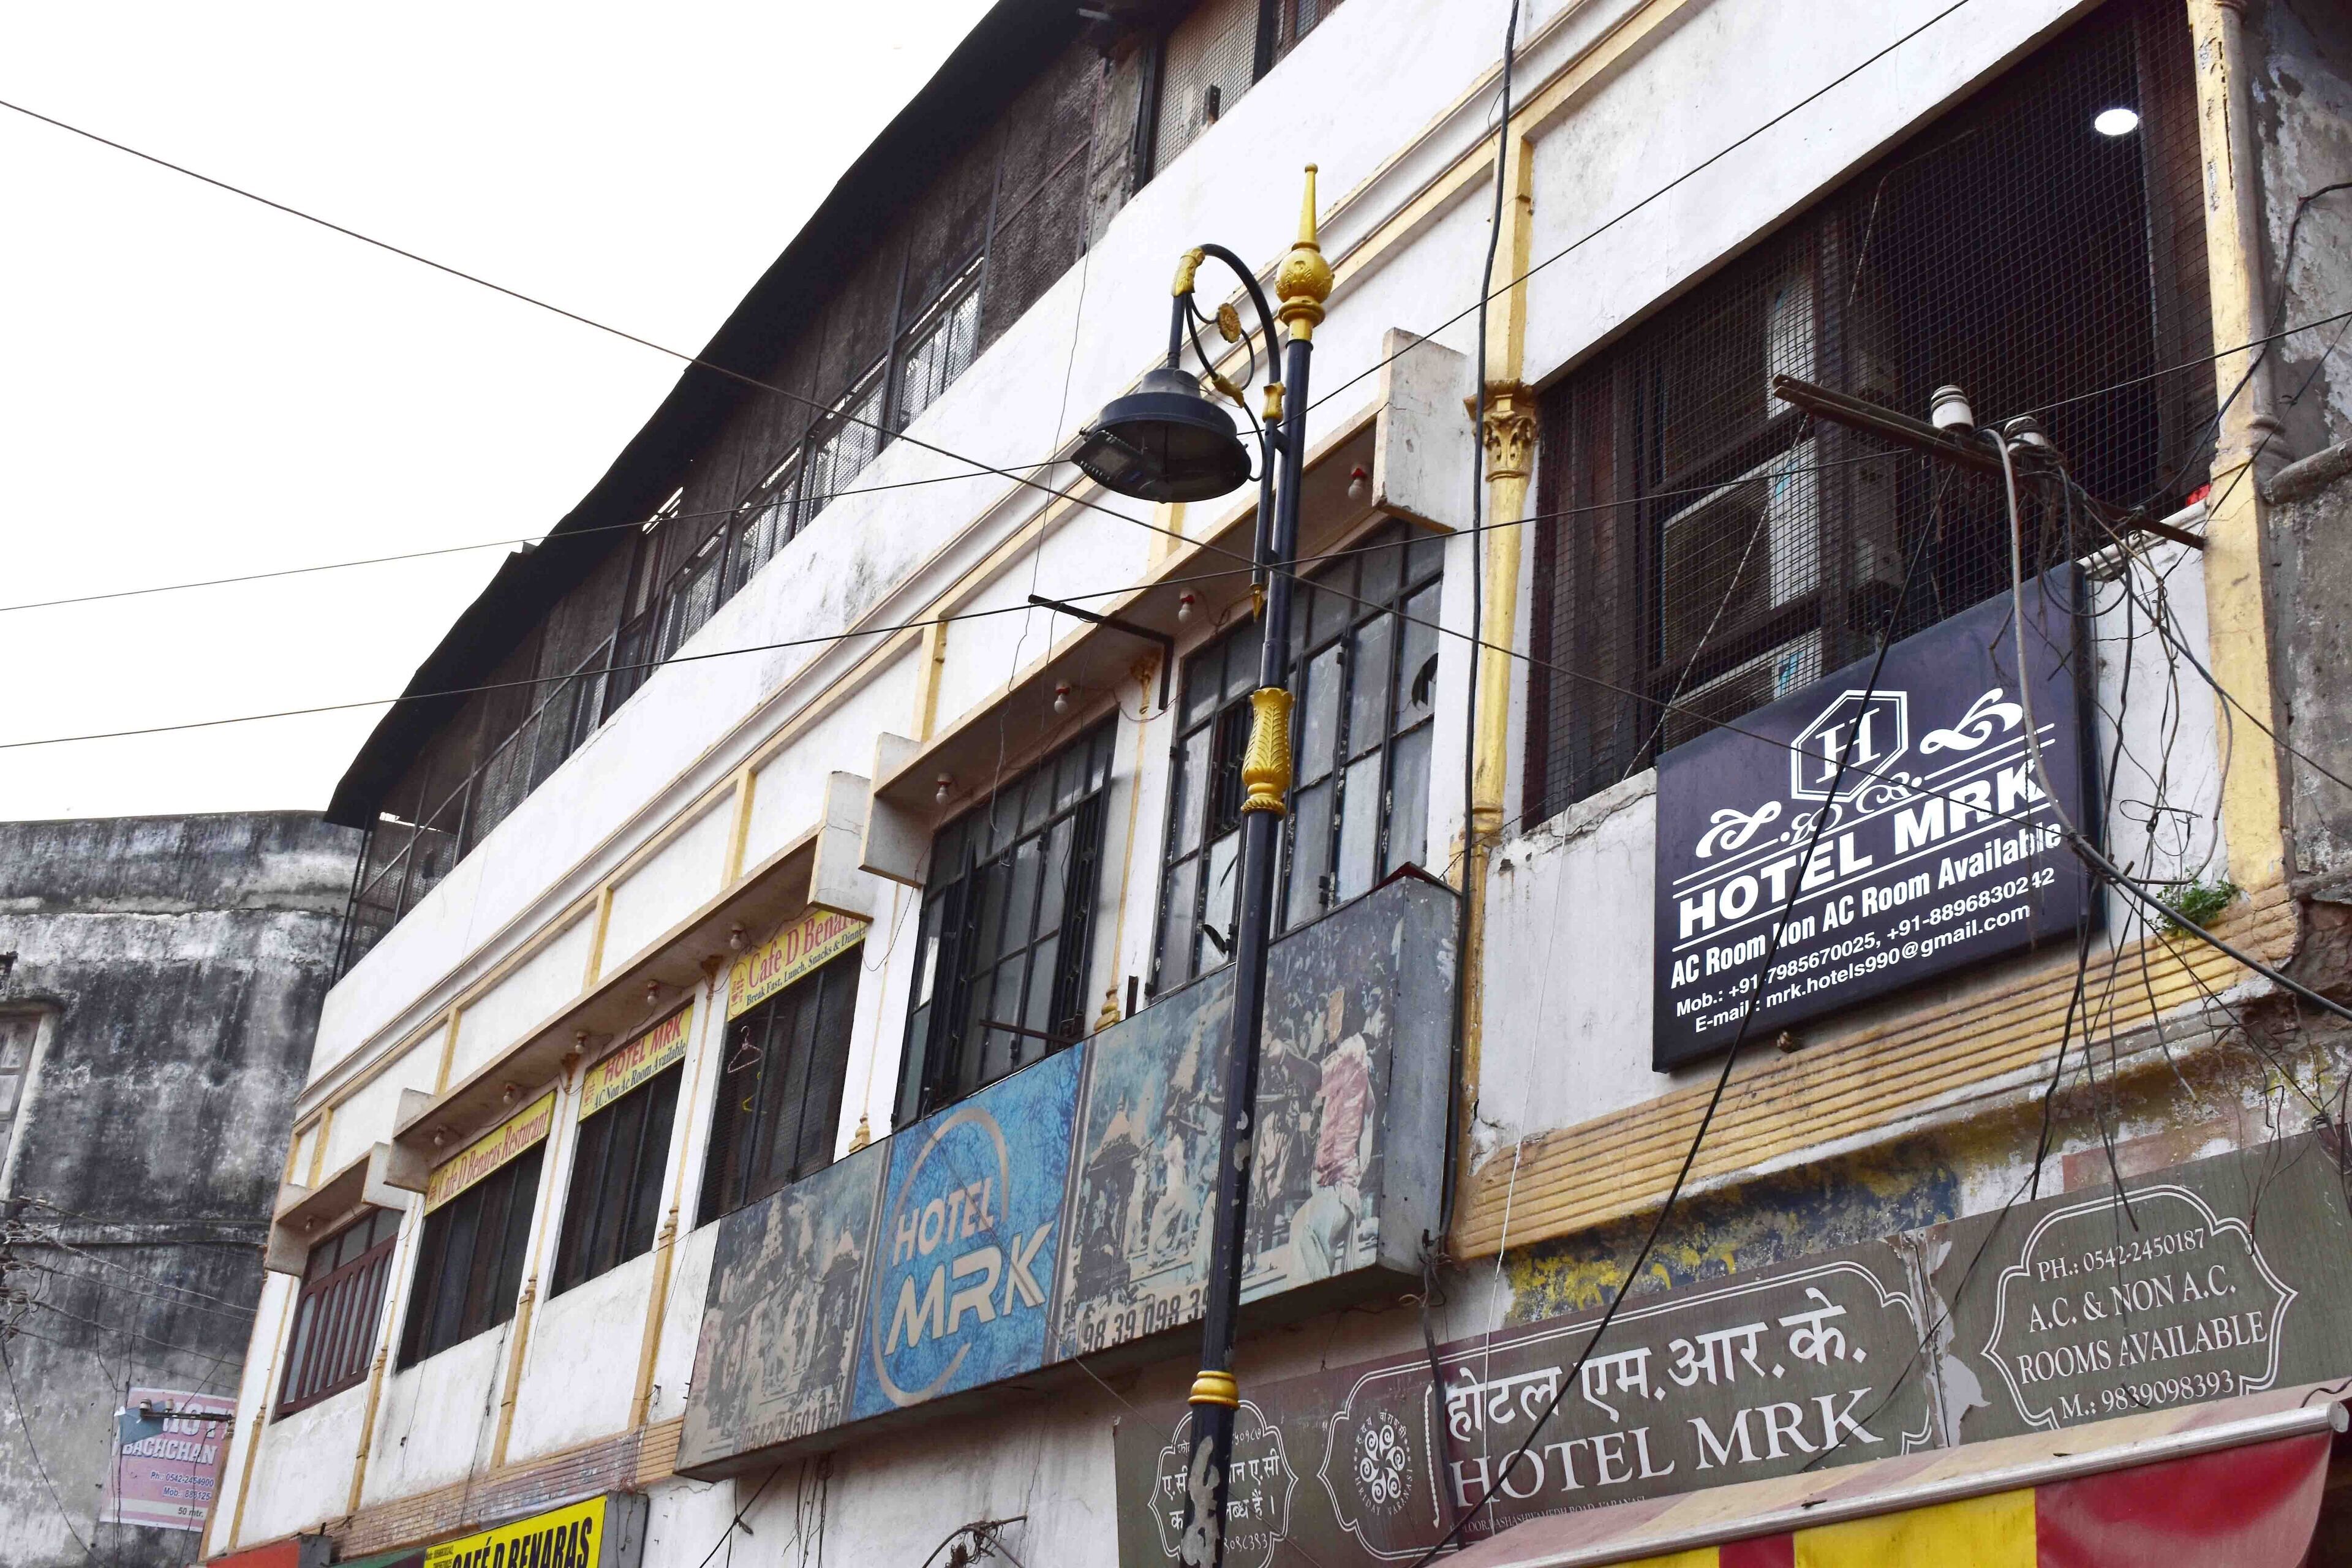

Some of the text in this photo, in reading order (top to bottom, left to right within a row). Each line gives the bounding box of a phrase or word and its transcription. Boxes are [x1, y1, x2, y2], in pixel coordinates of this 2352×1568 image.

[1679, 755, 2048, 940] HOTEL MRK
[1671, 822, 2062, 989] AC Room Non AC Room Available
[1728, 932, 1882, 998] +917985670025,
[1887, 867, 2055, 940] +91-8896830242
[746, 986, 766, 1006] Break
[808, 944, 832, 968] Snacks
[833, 940, 840, 953] &
[748, 940, 783, 988] Cafe
[785, 929, 799, 967] D
[1766, 904, 2030, 1009] mrk.hotels990@gmail.com
[604, 1012, 684, 1086] HOTEL MRK
[630, 1065, 652, 1087] Room
[652, 1038, 686, 1073] Available
[458, 1155, 467, 1190] D
[892, 1177, 994, 1267] HOTEL
[2084, 1227, 2205, 1272] 0542-2450187
[884, 1220, 1055, 1357] MRK
[2029, 1264, 2237, 1333] A.C. & NON A.C.
[2016, 1311, 2267, 1384] ROOMS AVAILABLE
[1444, 1366, 1563, 1442] होटल
[2101, 1369, 2234, 1412] 9839098393
[122, 1436, 219, 1466] BACHCHAN
[1449, 1387, 1885, 1508] HOTEL MRK
[178, 1507, 187, 1516] 50
[1354, 1469, 1414, 1517] HRIDAY VARANASI
[507, 1516, 593, 1568] BENARAS
